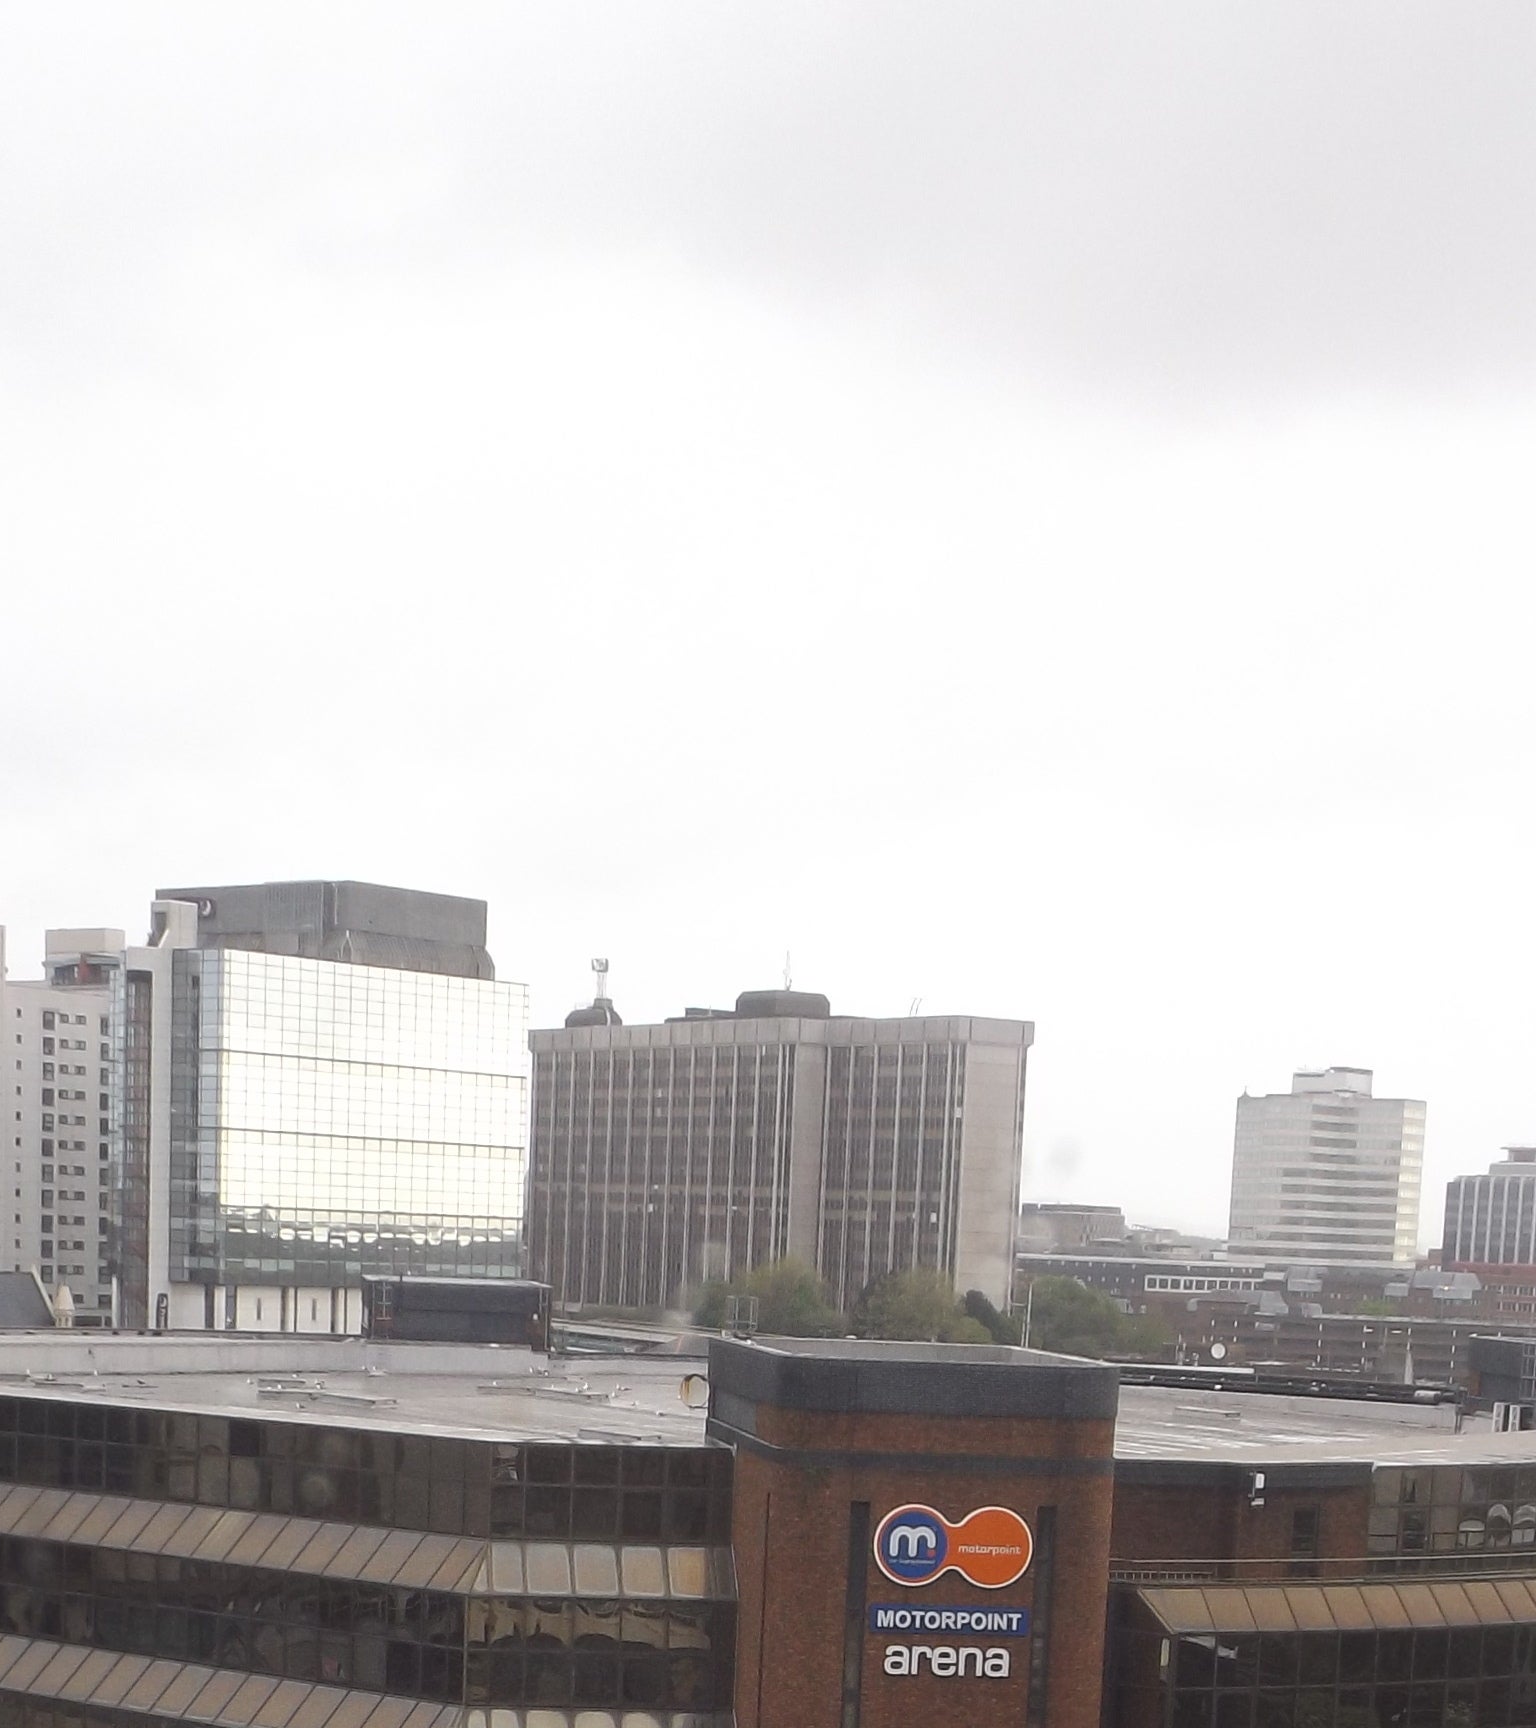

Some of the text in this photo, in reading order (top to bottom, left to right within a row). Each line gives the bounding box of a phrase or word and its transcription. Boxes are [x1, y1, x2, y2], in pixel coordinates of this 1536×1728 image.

[958, 1543, 1021, 1556] motorpoint
[876, 1609, 1023, 1631] MOTORPOINT
[883, 1644, 1011, 1678] arena
